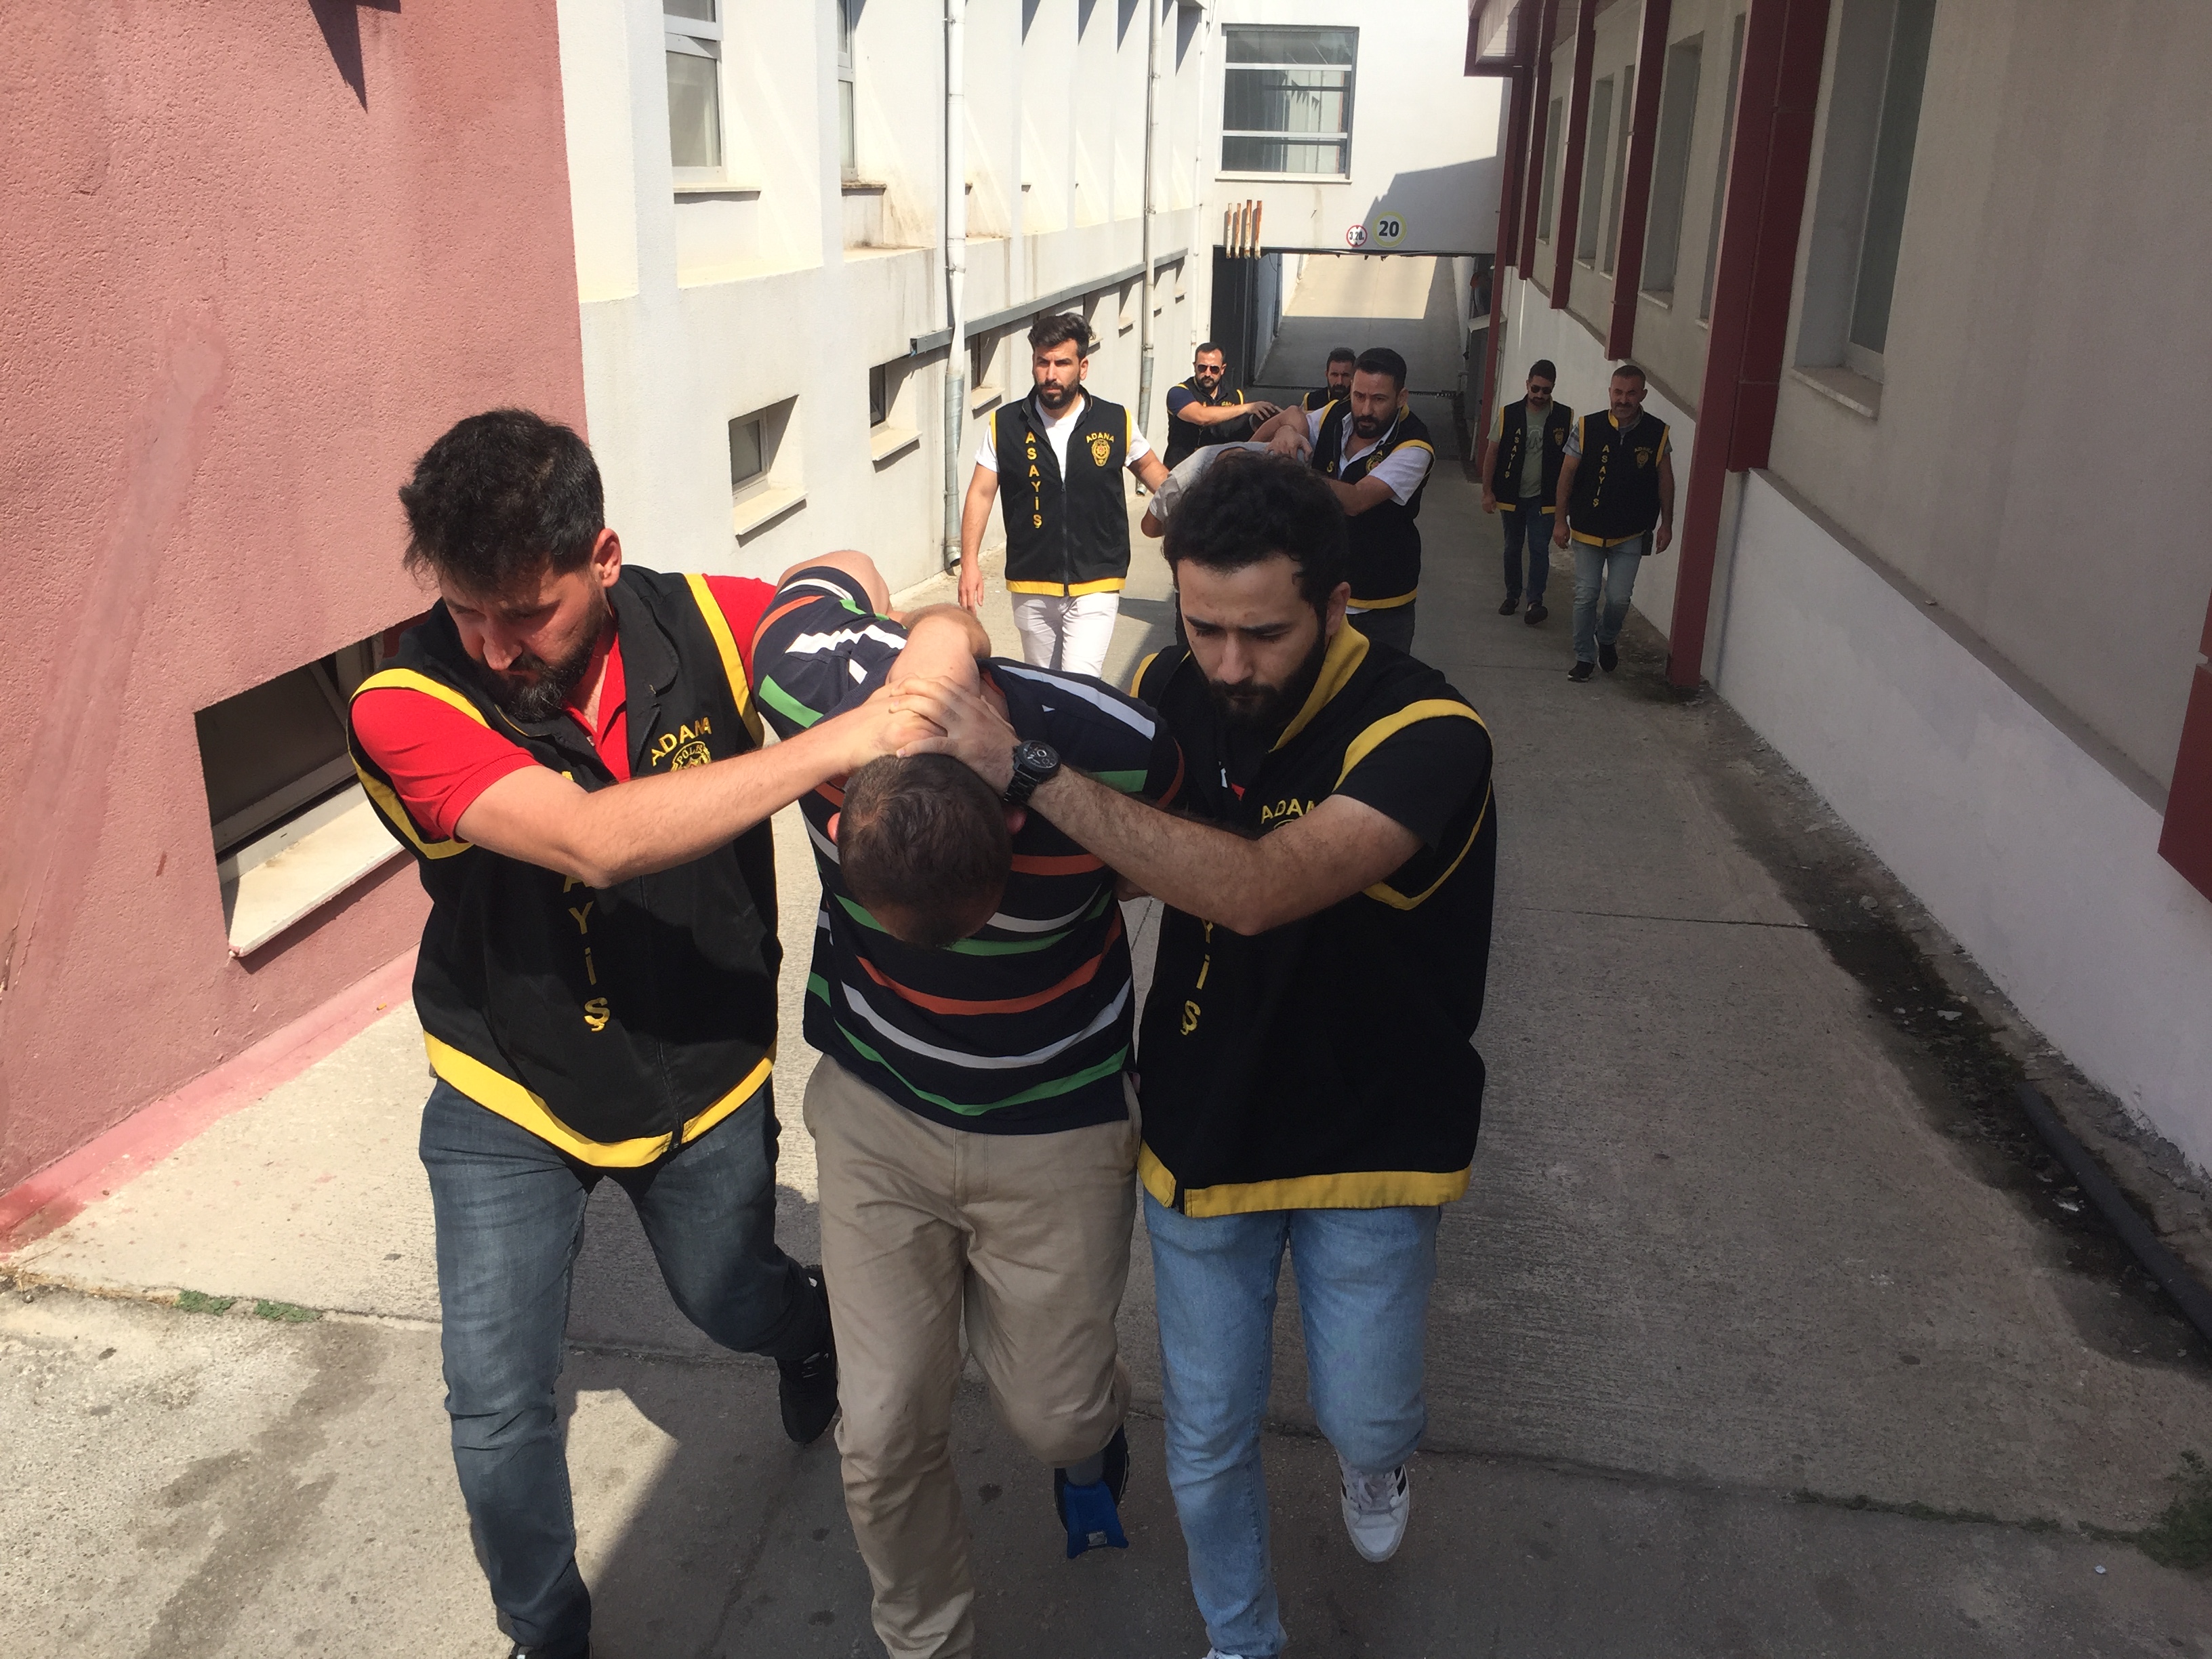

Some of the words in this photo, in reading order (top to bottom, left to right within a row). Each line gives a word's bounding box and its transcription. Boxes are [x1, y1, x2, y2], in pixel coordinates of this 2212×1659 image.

[1378, 220, 1399, 237] 20
[1086, 432, 1114, 443] ADANA
[1025, 431, 1042, 529] ASAYİŞ
